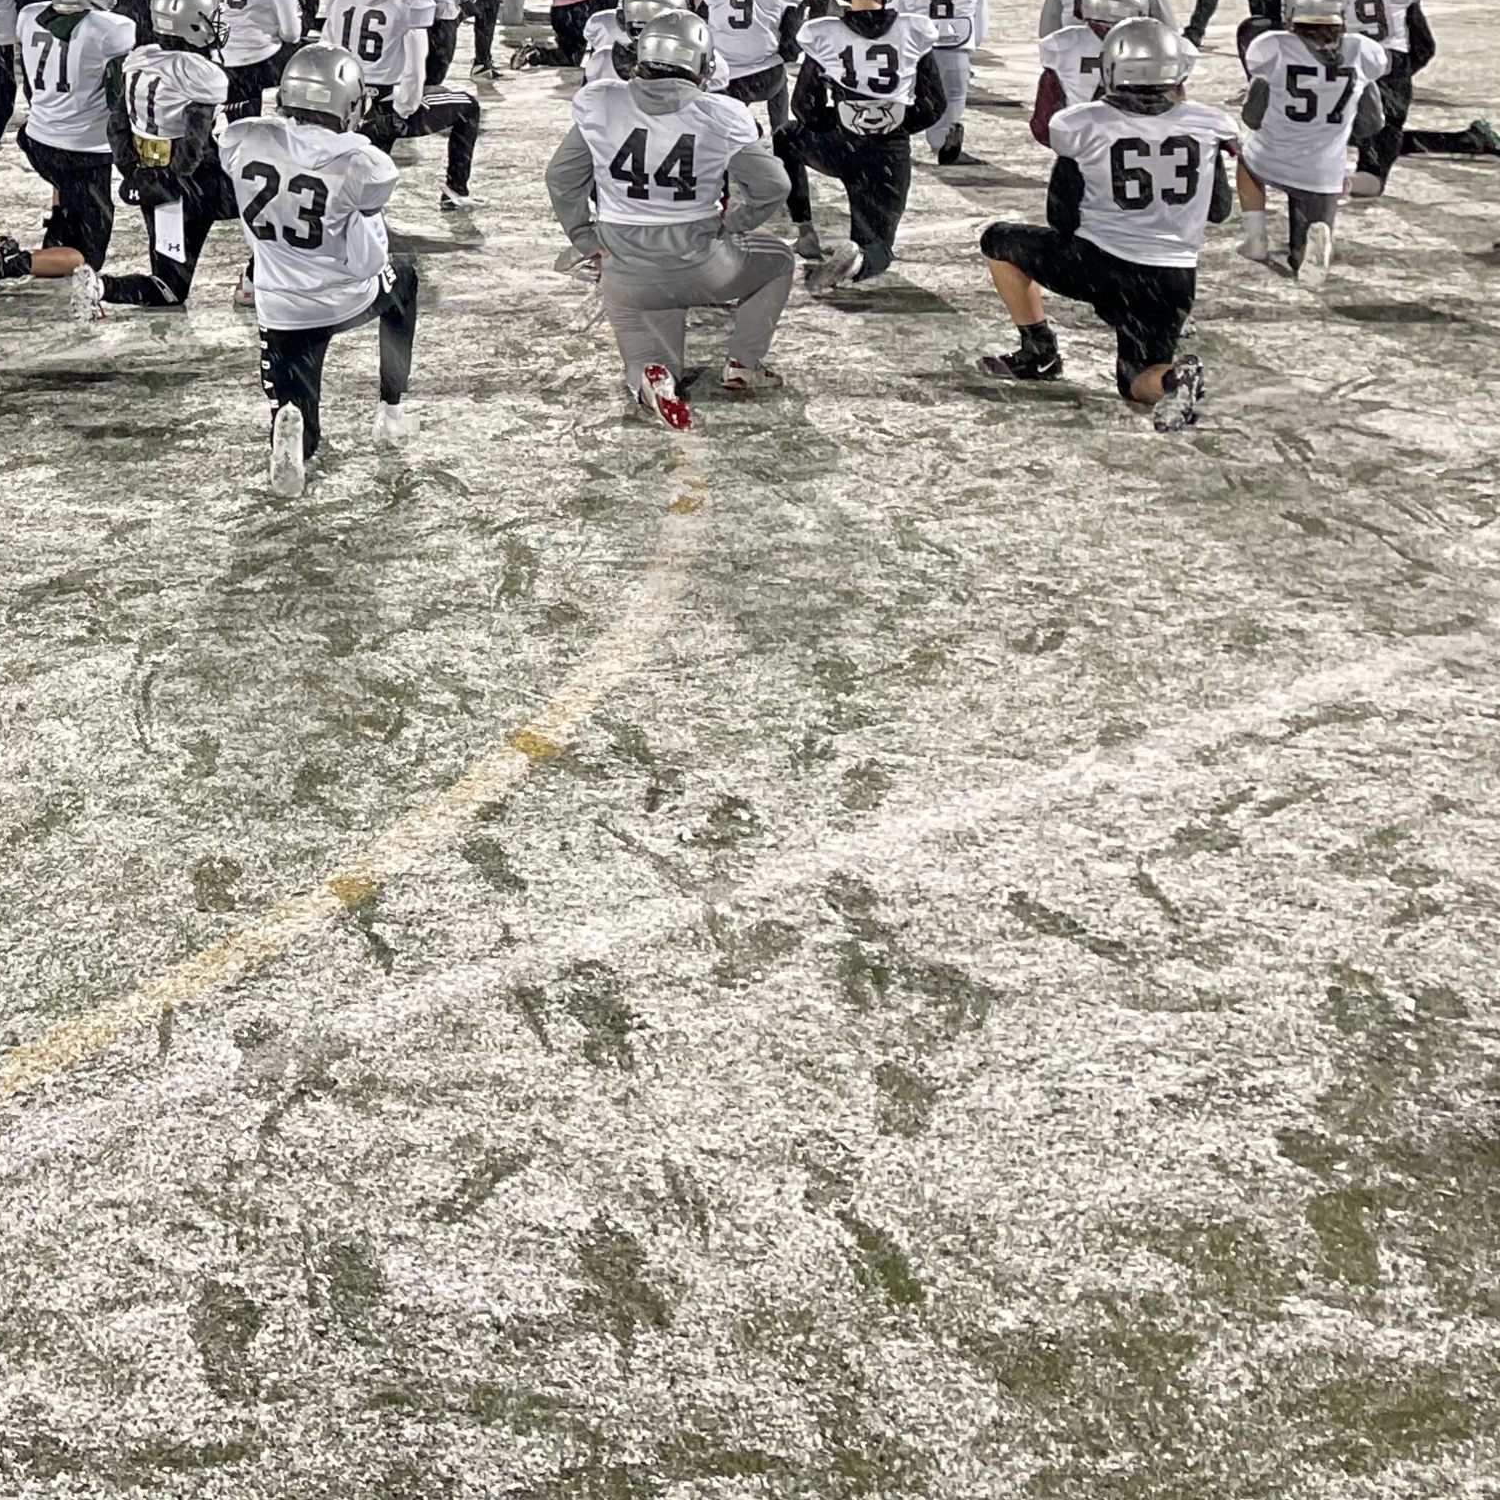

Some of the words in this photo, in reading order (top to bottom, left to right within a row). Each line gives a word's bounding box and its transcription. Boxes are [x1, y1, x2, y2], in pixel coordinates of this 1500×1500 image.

[31, 31, 70, 92] 71
[342, 6, 386, 62] 16
[839, 44, 899, 94] 13
[1285, 64, 1357, 124] 57
[130, 69, 161, 136] 11
[609, 127, 697, 201] 44
[1111, 135, 1200, 210] 63
[241, 160, 329, 249] 23
